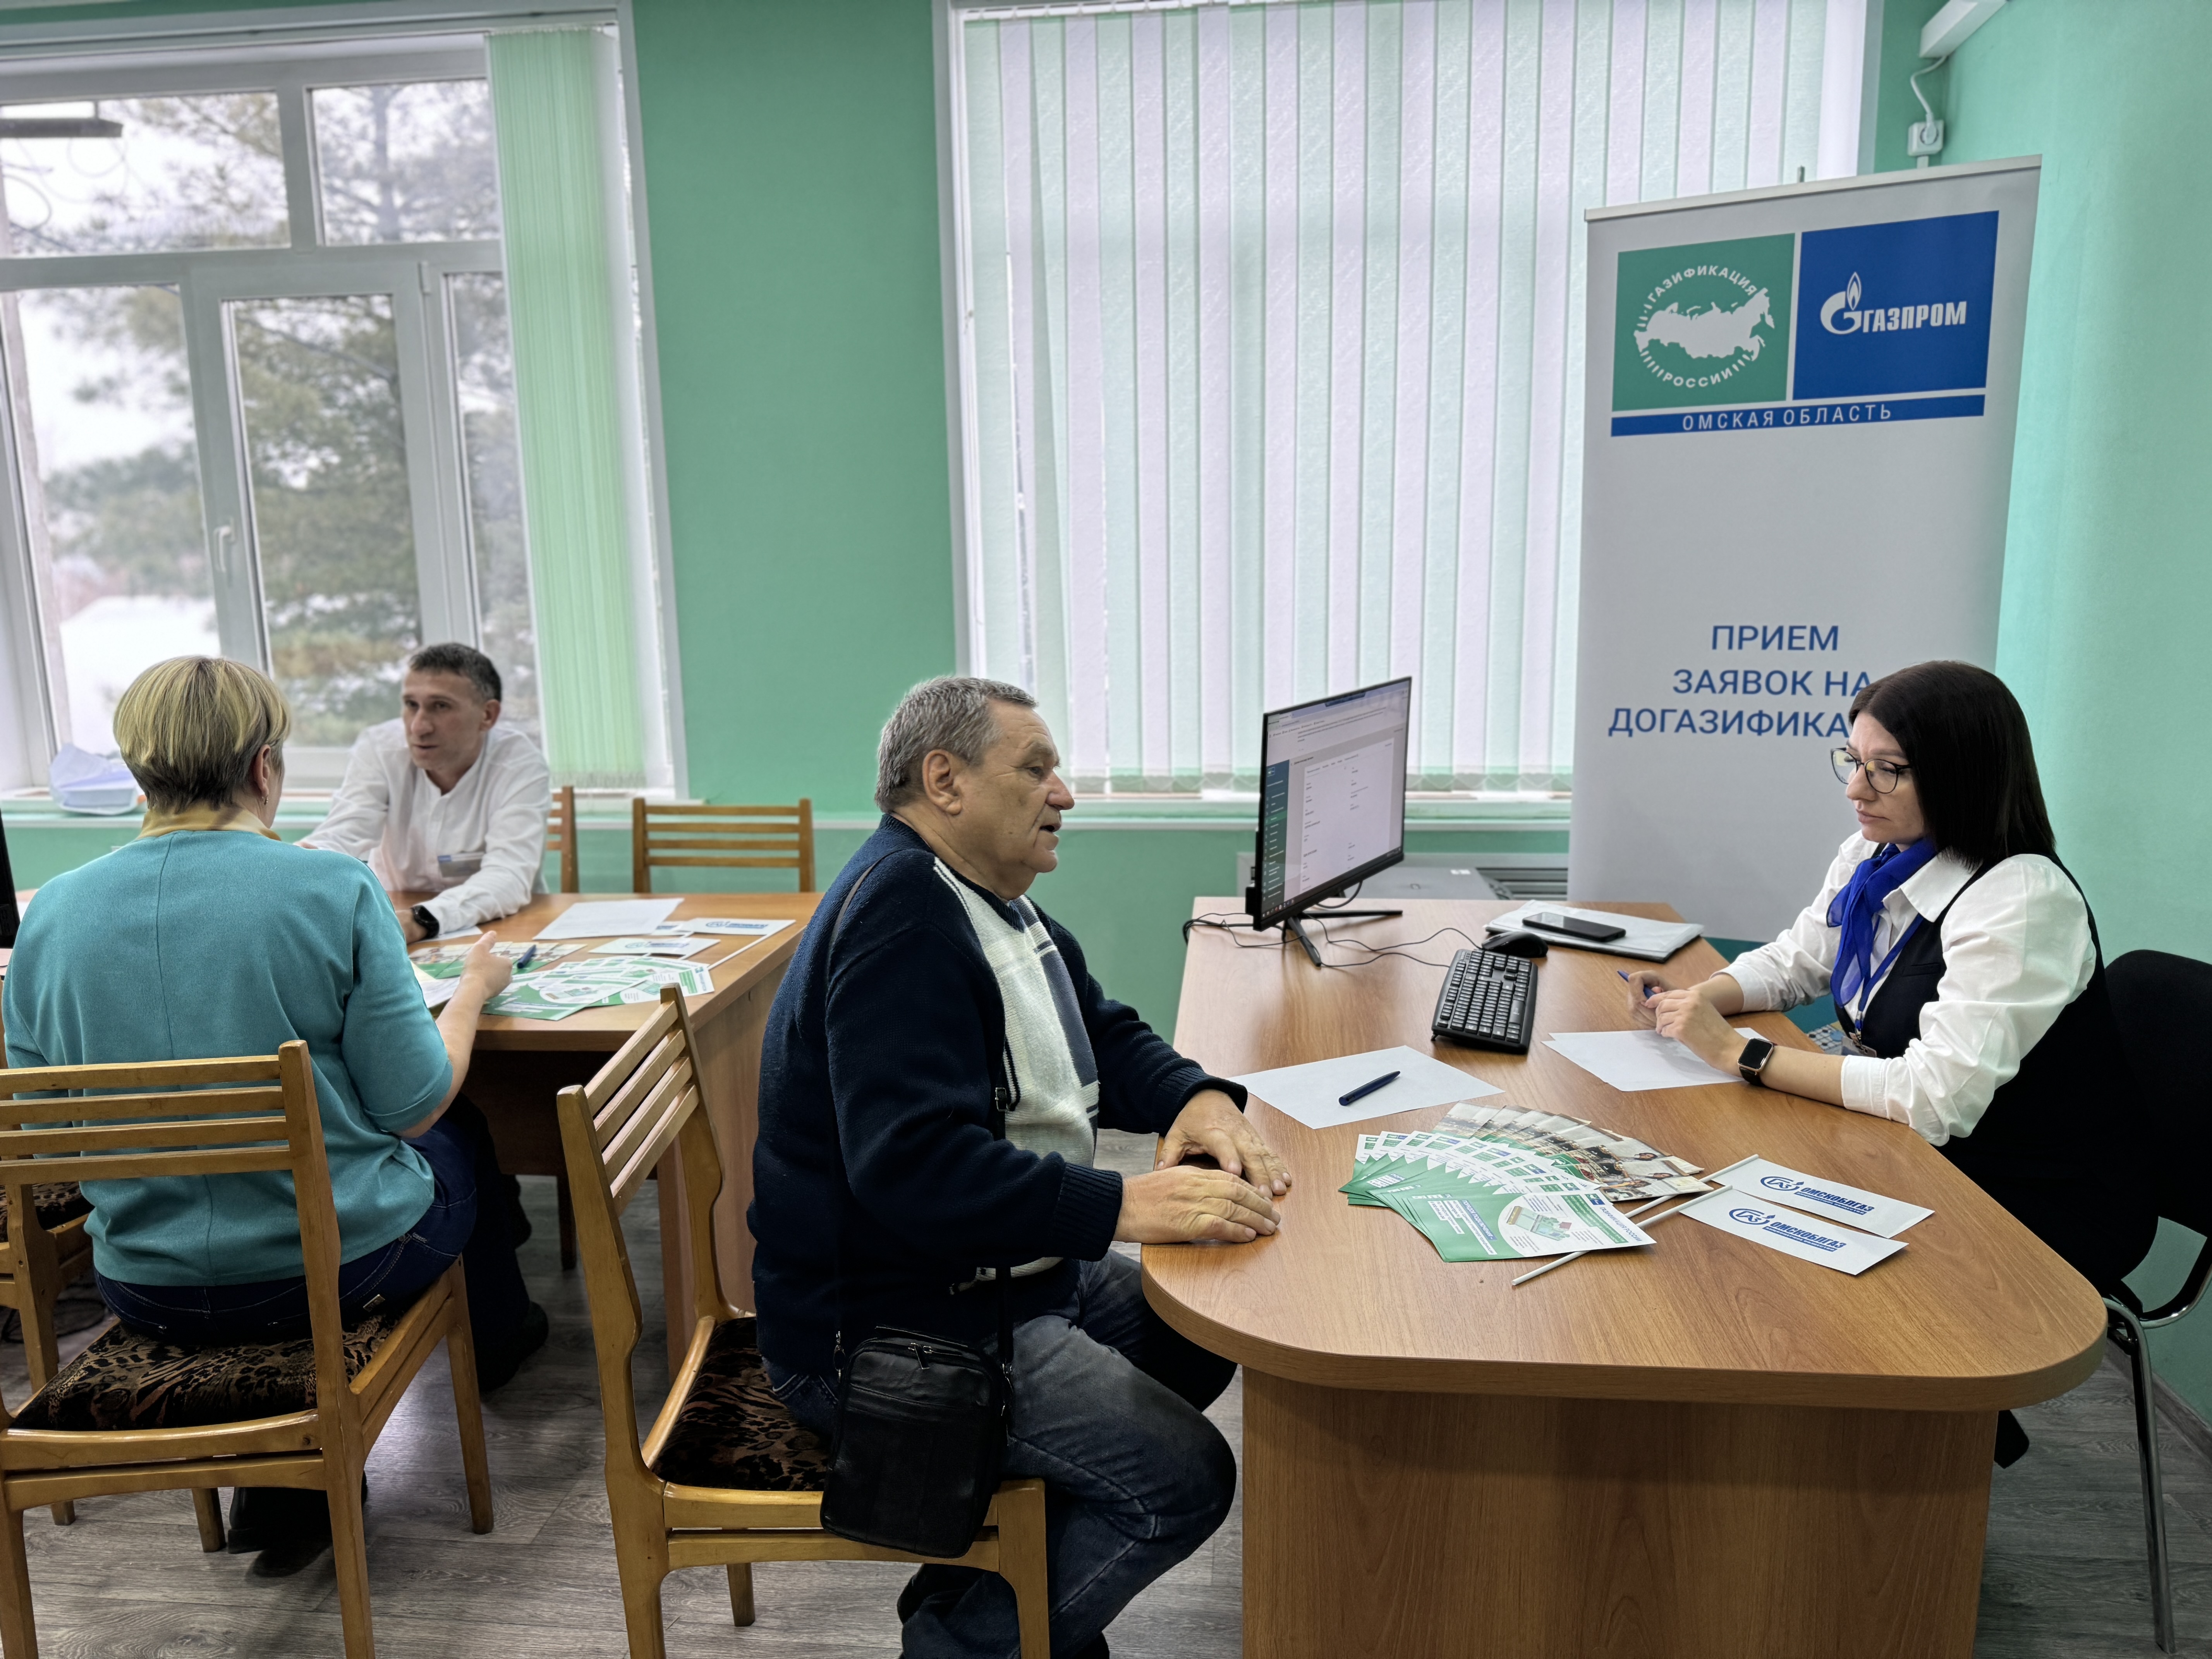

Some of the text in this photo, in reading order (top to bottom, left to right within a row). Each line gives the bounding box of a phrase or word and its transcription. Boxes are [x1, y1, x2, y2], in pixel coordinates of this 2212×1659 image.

[1647, 265, 1757, 302] ГАЗИФИКАЦИЯ
[1863, 301, 1967, 333] ГАЗПРОМ
[1663, 368, 1733, 388] РОССИИ
[1682, 404, 1891, 431] ОМСКАЯ ОБЛАСТЬ
[1711, 625, 1839, 651] ПРИЕМ
[1673, 669, 1871, 697] ЗАЯВОК НА
[1800, 1187, 1875, 1212] ОМСКОБЛГАЗ
[1599, 1207, 1627, 1228] ГАЗИФИКАЦИЯ
[1623, 1228, 1642, 1242] РОССИИ
[1770, 1222, 1847, 1249] ОМСКОБЛГАЗ
